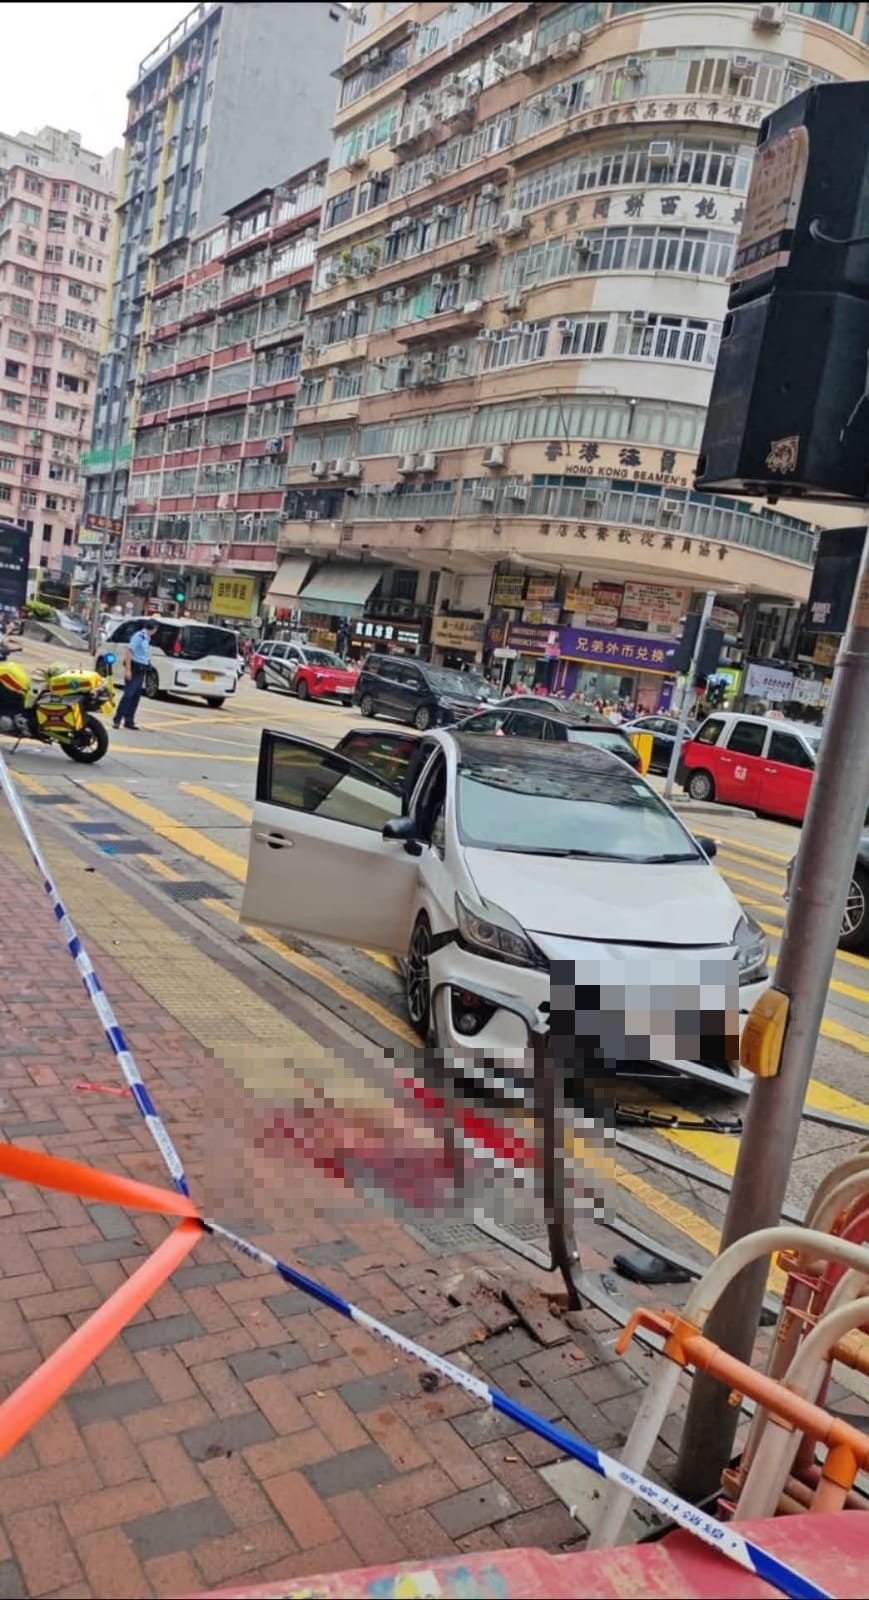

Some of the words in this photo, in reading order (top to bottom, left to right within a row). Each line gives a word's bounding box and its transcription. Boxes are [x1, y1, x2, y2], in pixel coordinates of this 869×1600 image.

[545, 441, 697, 476] 香港海員
[565, 464, 594, 475] HONG
[598, 467, 628, 478] KONG
[633, 470, 688, 487] SEAMEN'S
